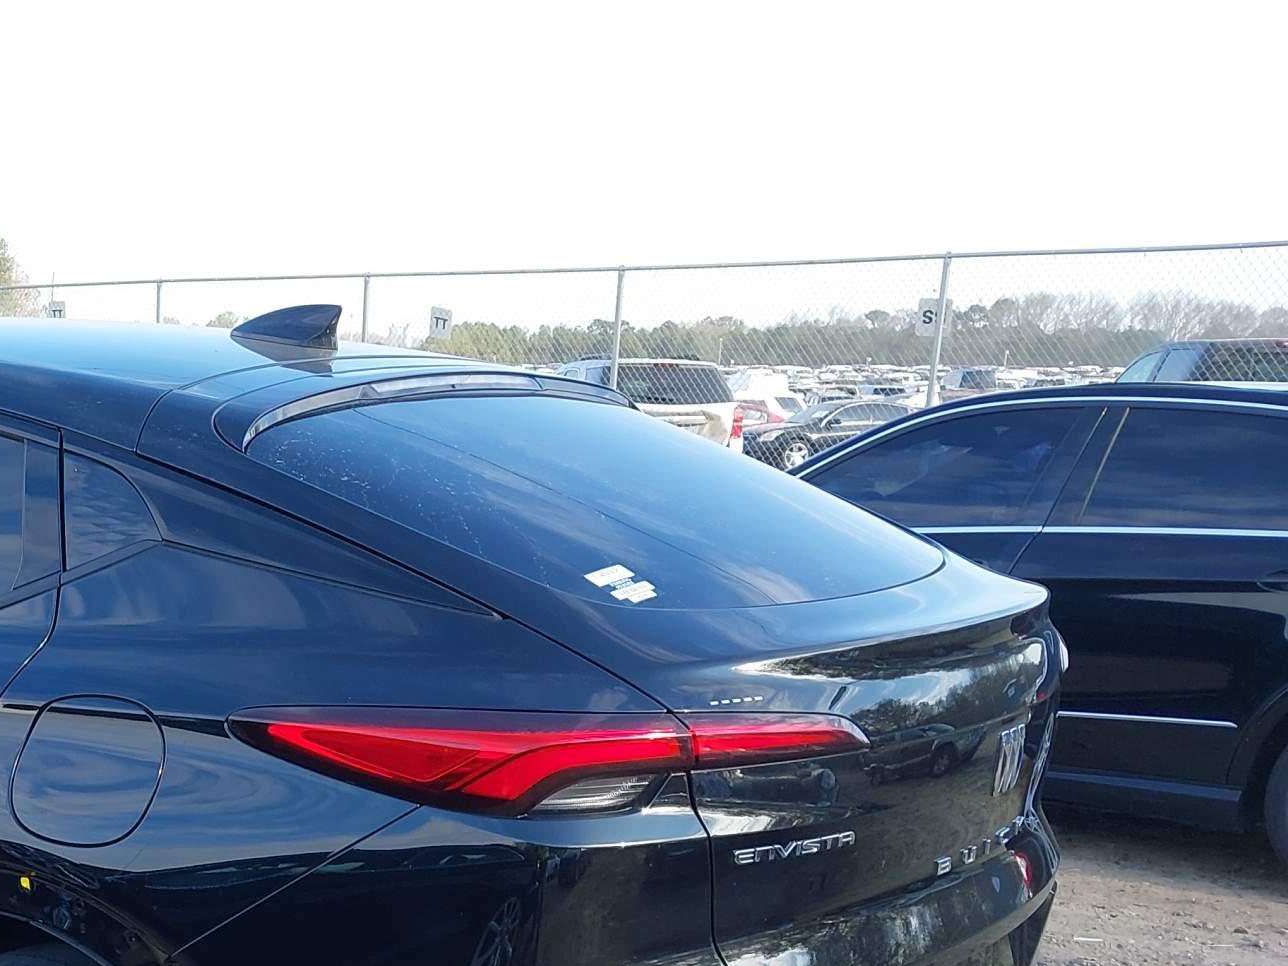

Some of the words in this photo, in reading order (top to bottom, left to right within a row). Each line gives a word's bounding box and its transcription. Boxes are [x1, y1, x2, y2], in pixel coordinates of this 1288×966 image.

[433, 316, 449, 330] TT
[733, 831, 855, 865] ENVISTA
[934, 815, 1025, 876] BUICK
